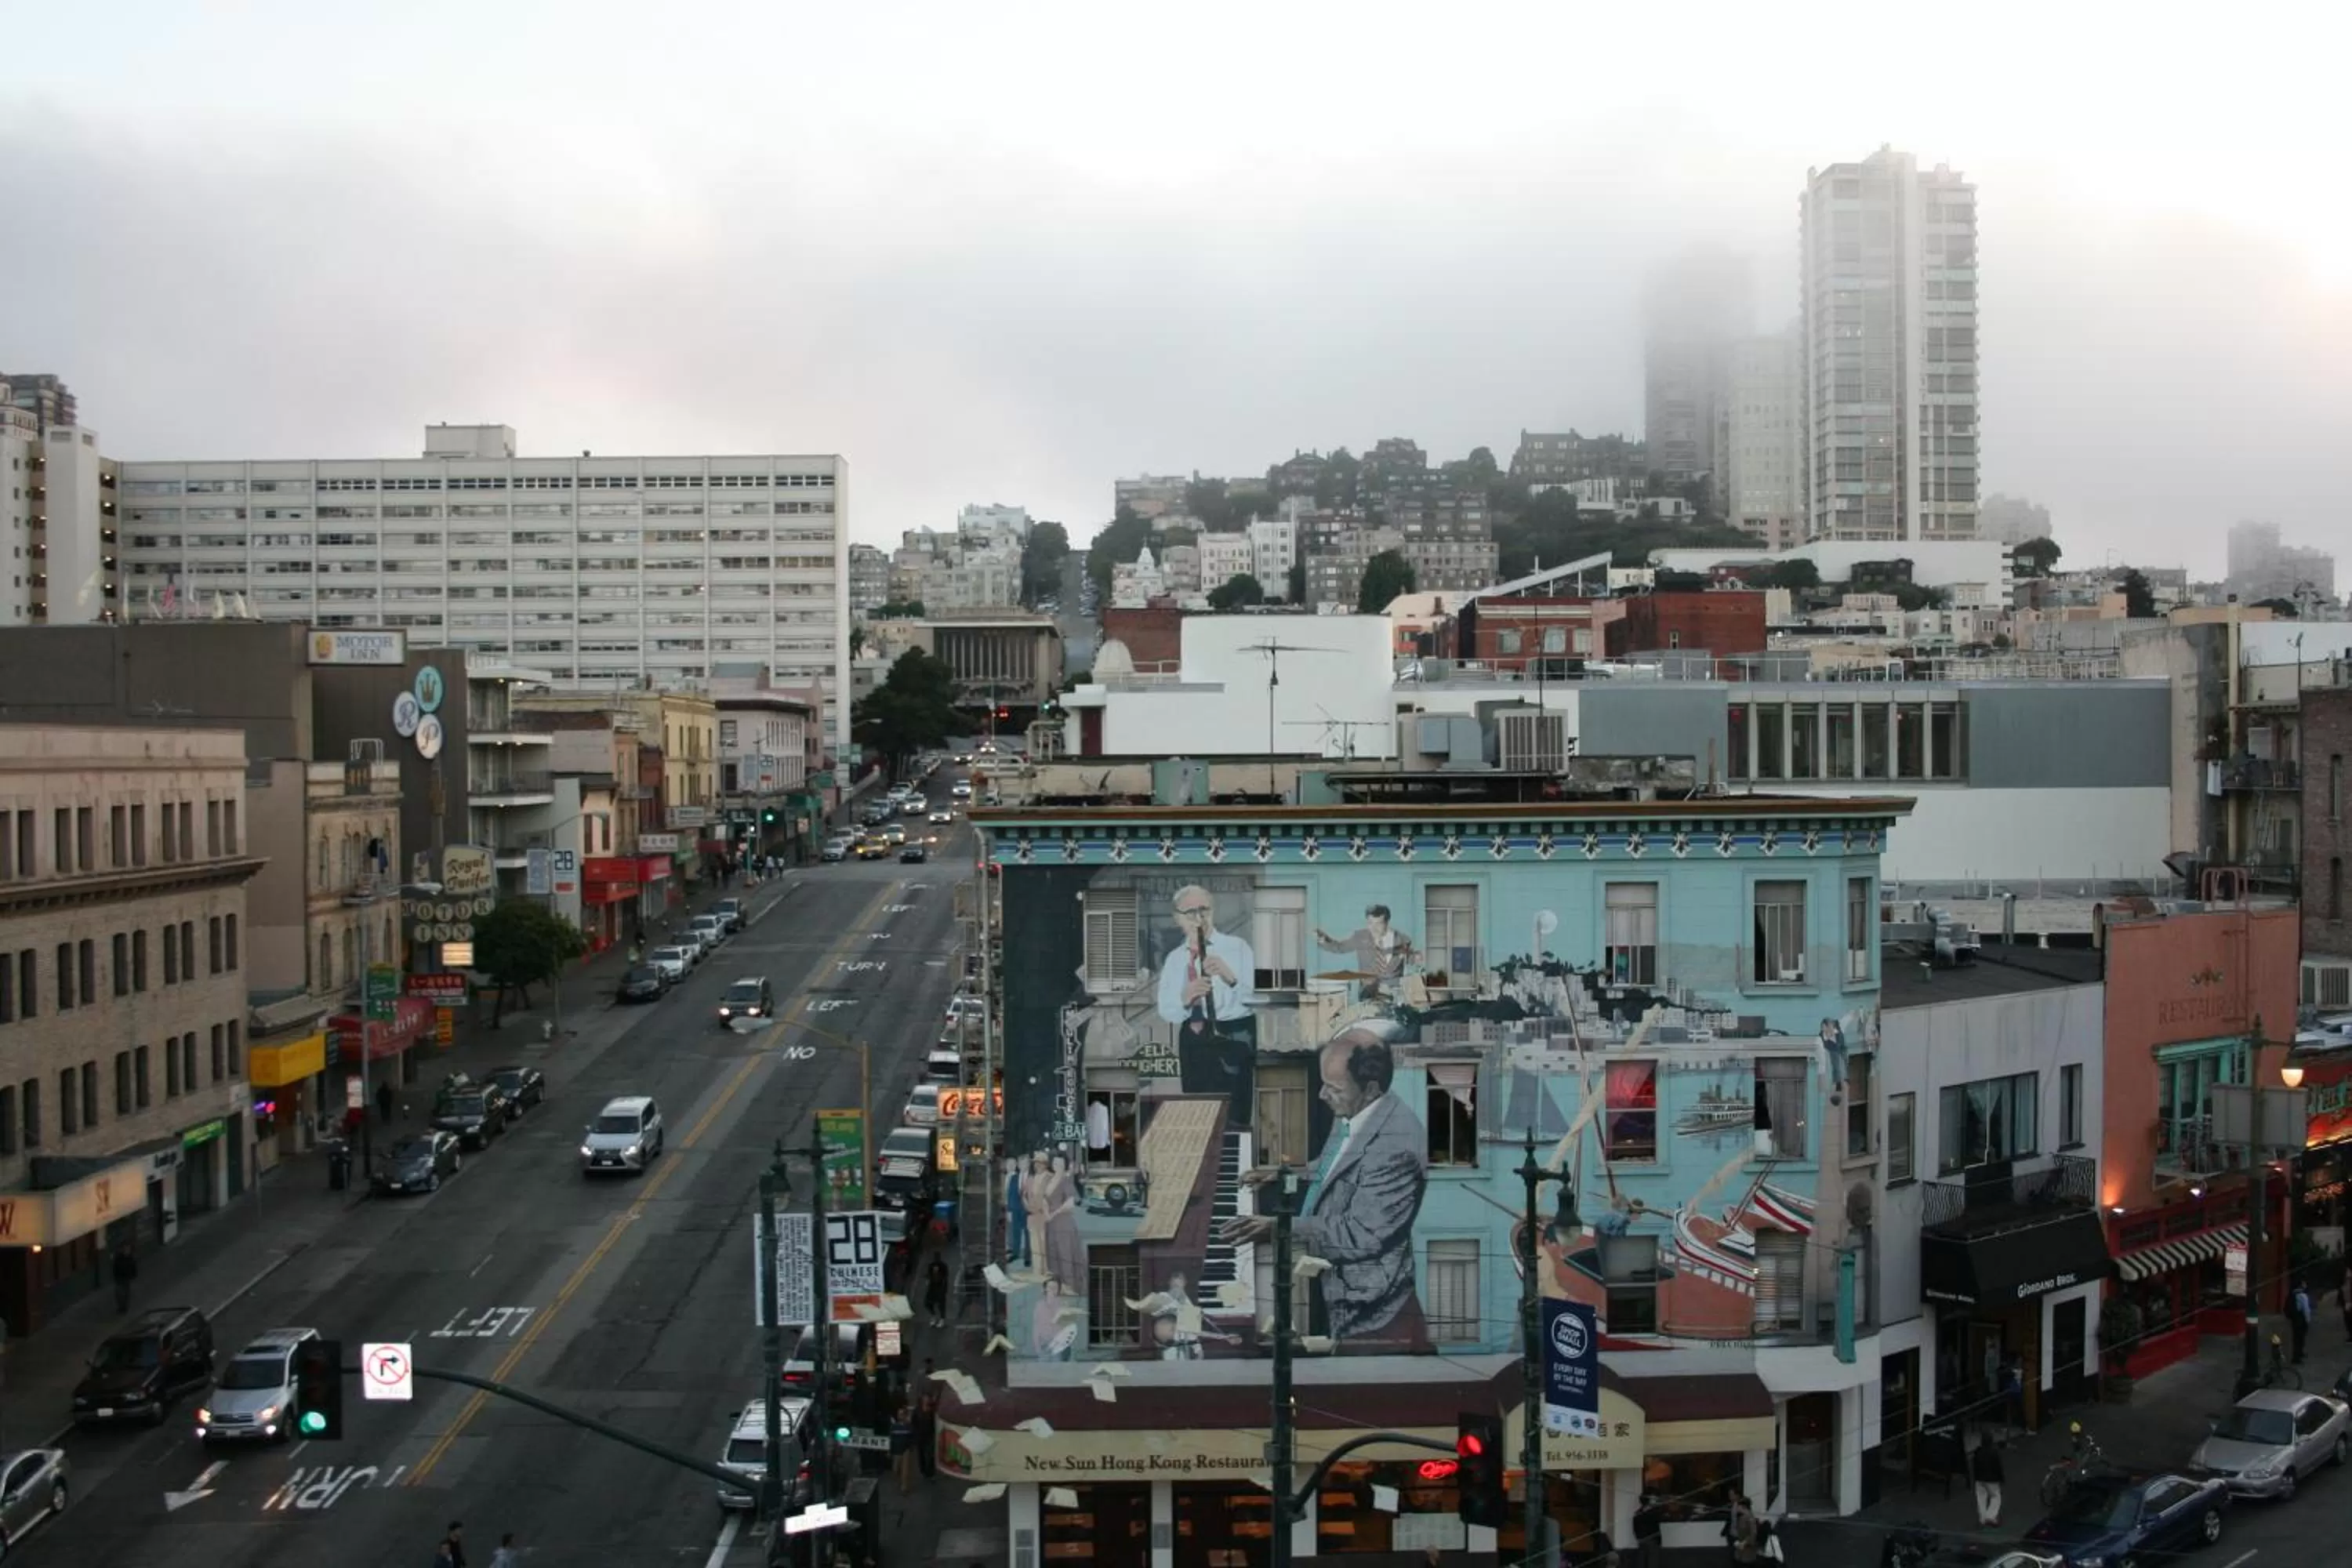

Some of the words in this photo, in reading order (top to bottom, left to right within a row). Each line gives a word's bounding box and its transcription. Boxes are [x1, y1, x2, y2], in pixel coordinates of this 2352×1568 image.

[337, 636, 394, 648] MOTOR
[350, 649, 380, 659] INN
[554, 851, 574, 870] 28
[782, 1046, 817, 1060] NO
[827, 1214, 878, 1265] 28
[829, 1266, 879, 1277] CHINESE
[429, 1307, 537, 1337] LEFT
[840, 1436, 887, 1448] RANT
[1025, 1455, 1059, 1471] New
[1065, 1454, 1095, 1470] Sun
[1101, 1454, 1143, 1472] Hong
[1149, 1454, 1191, 1472] Kong
[1196, 1454, 1272, 1469] Restaura
